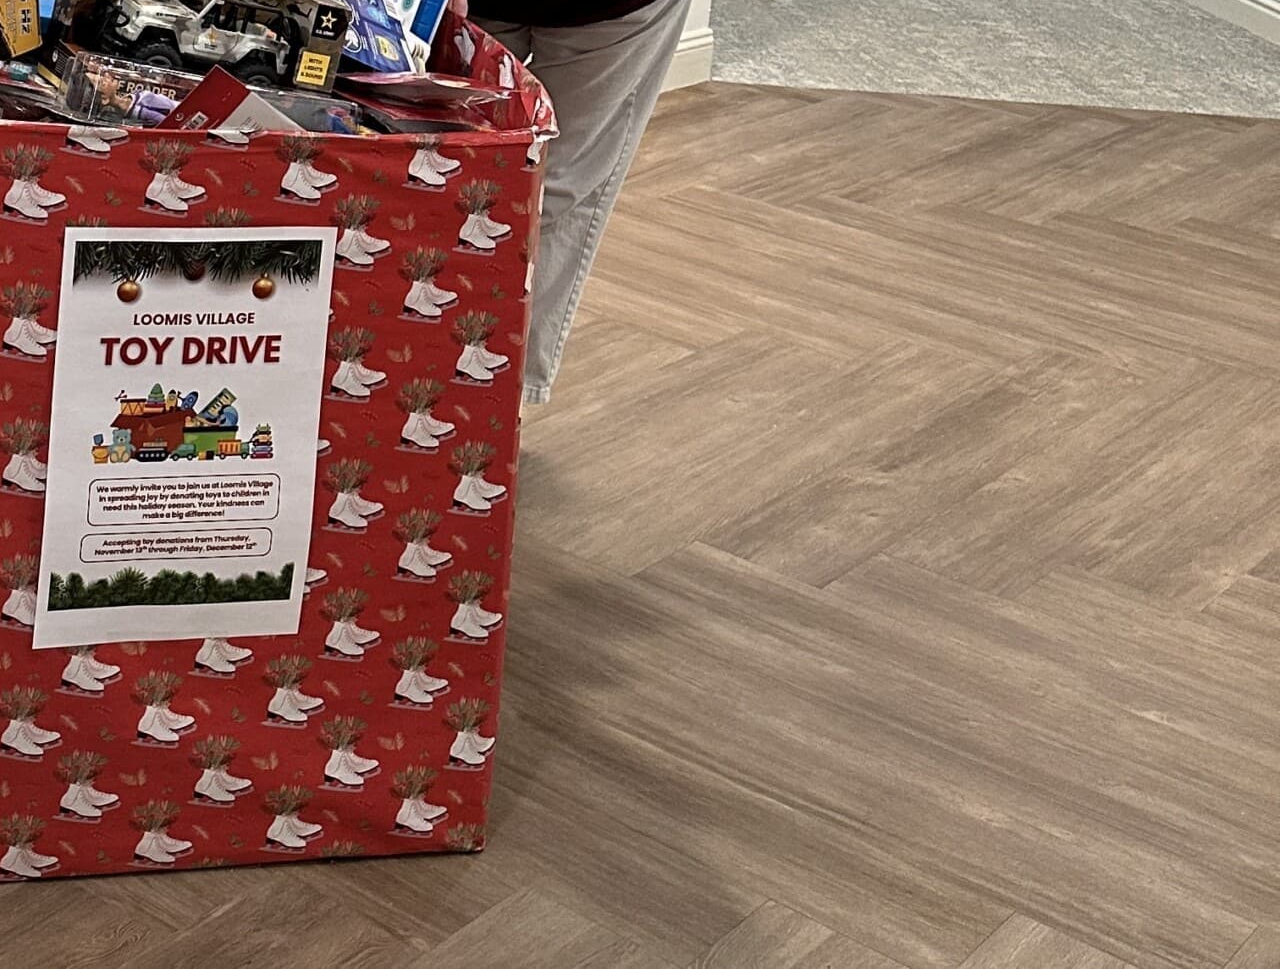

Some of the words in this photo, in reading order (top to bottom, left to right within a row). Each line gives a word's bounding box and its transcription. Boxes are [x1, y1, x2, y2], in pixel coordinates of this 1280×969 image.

[133, 313, 192, 326] LOOMIS
[196, 312, 255, 325] VILLAGE
[100, 336, 175, 366] TOY
[181, 335, 282, 365] DRIVE
[96, 485, 110, 493] We
[110, 485, 139, 494] warmly
[140, 483, 161, 492] invite
[162, 484, 177, 492] you
[186, 482, 200, 491] join
[248, 480, 274, 489] Village
[107, 494, 146, 503] spreading
[146, 494, 159, 503] joy
[159, 492, 169, 501] by
[170, 492, 205, 501] donating
[205, 491, 221, 500] toys
[231, 489, 261, 497] children
[123, 503, 137, 511] this
[138, 502, 167, 511] holiday
[168, 501, 196, 509] season.
[216, 499, 249, 507] kindness
[172, 511, 184, 520] big
[184, 510, 225, 518] difference!
[102, 538, 142, 548] Accepting
[142, 537, 155, 546] toy
[155, 536, 194, 544] donations
[194, 535, 214, 543] from
[214, 534, 251, 543] Thursday,
[94, 546, 134, 556] November
[148, 545, 179, 554] through
[179, 544, 205, 553] Friday,
[206, 543, 244, 552] December
